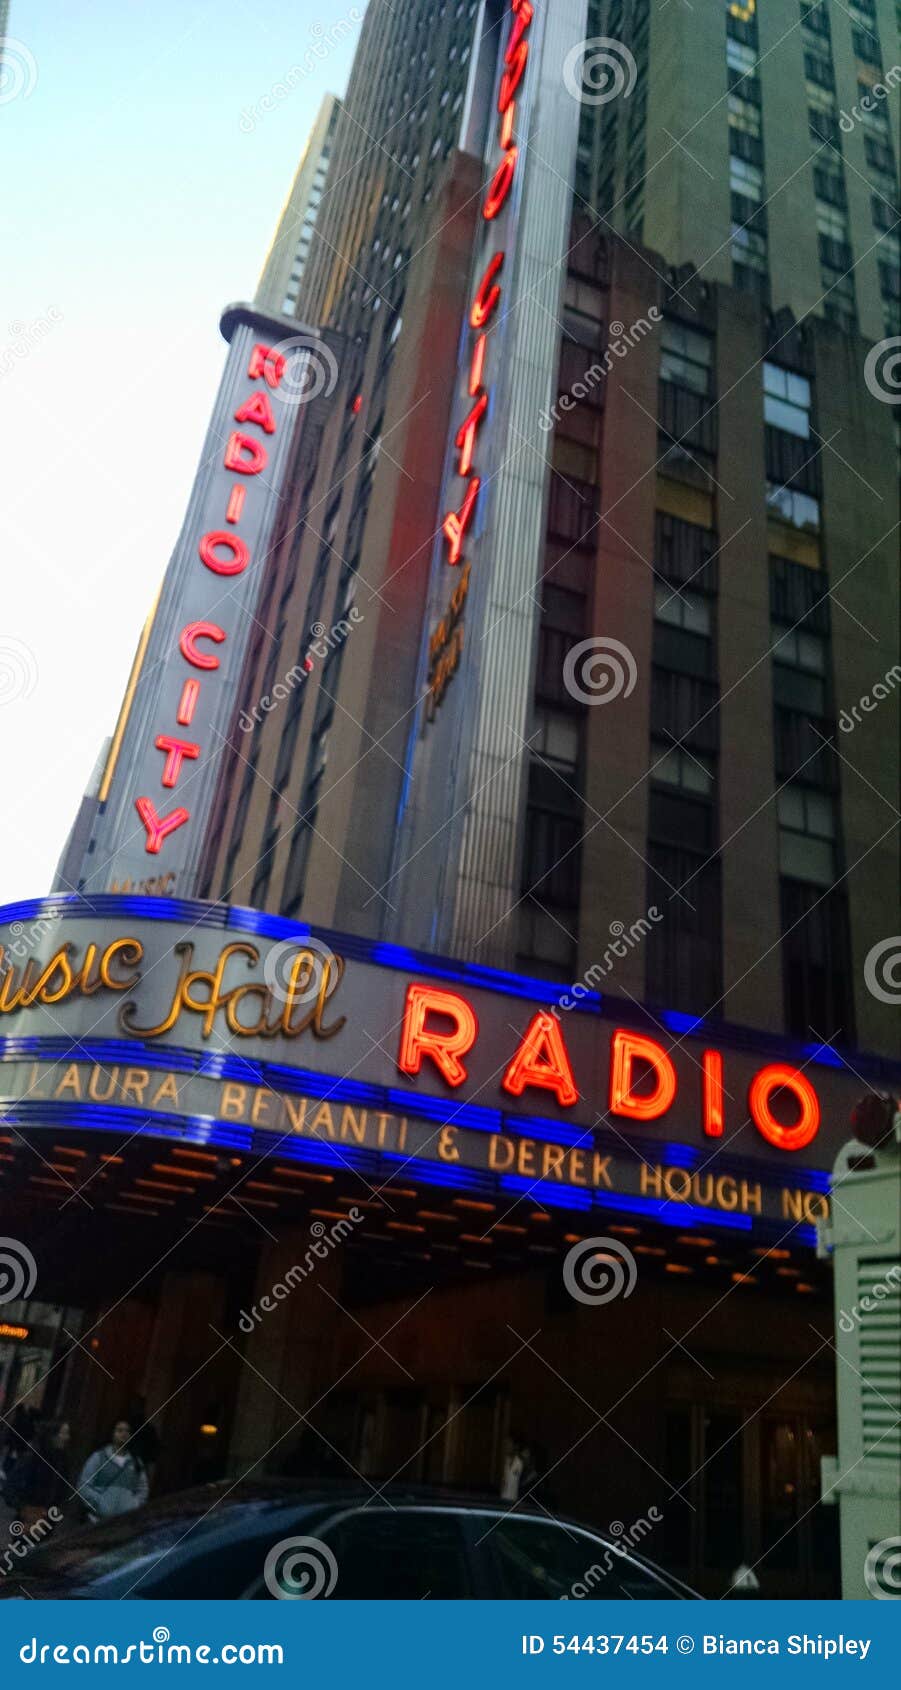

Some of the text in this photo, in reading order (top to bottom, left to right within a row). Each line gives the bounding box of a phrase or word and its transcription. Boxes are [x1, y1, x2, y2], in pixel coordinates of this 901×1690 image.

[484, 0, 534, 220] ADIO
[443, 251, 506, 566] CITY
[134, 343, 287, 855] RADIO CITY
[0, 937, 347, 1041] usic Hall
[398, 981, 822, 1153] RADIO
[27, 1061, 180, 1108] LAURA
[218, 1081, 409, 1150] BENANTI
[438, 1126, 460, 1161] &
[488, 1133, 614, 1188] DEREK
[639, 1163, 763, 1213] HOUGH
